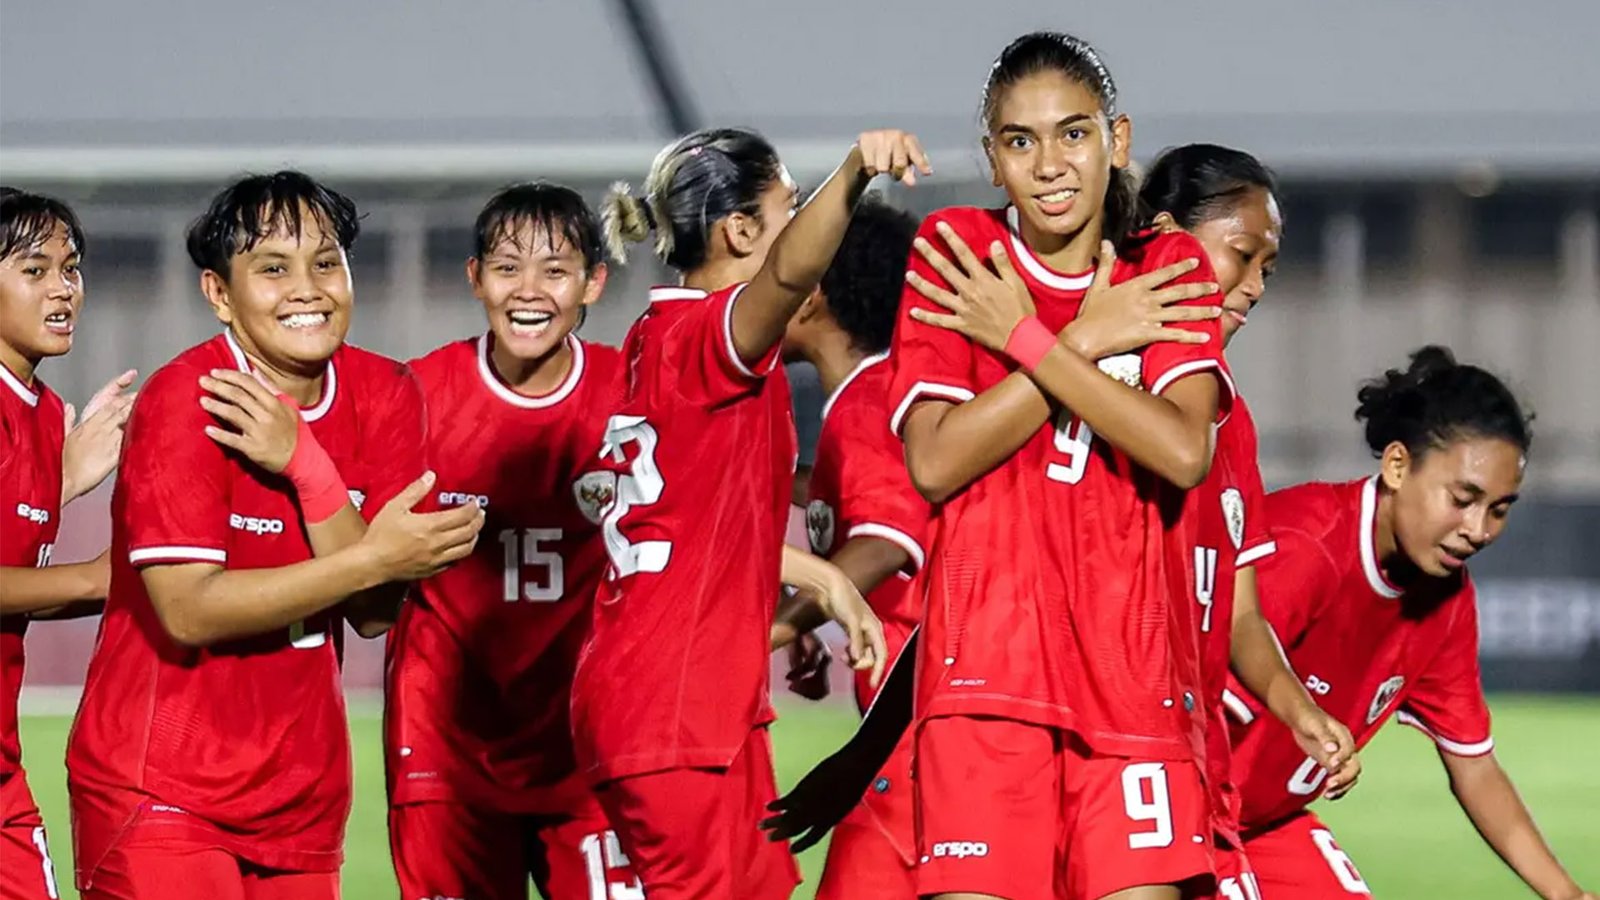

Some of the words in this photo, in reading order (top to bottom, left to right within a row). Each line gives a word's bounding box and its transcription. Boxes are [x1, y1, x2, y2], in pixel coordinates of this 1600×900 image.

[229, 513, 284, 535] erspo
[499, 528, 563, 602] 15
[1121, 762, 1174, 849] 9
[933, 841, 989, 859] erspo
